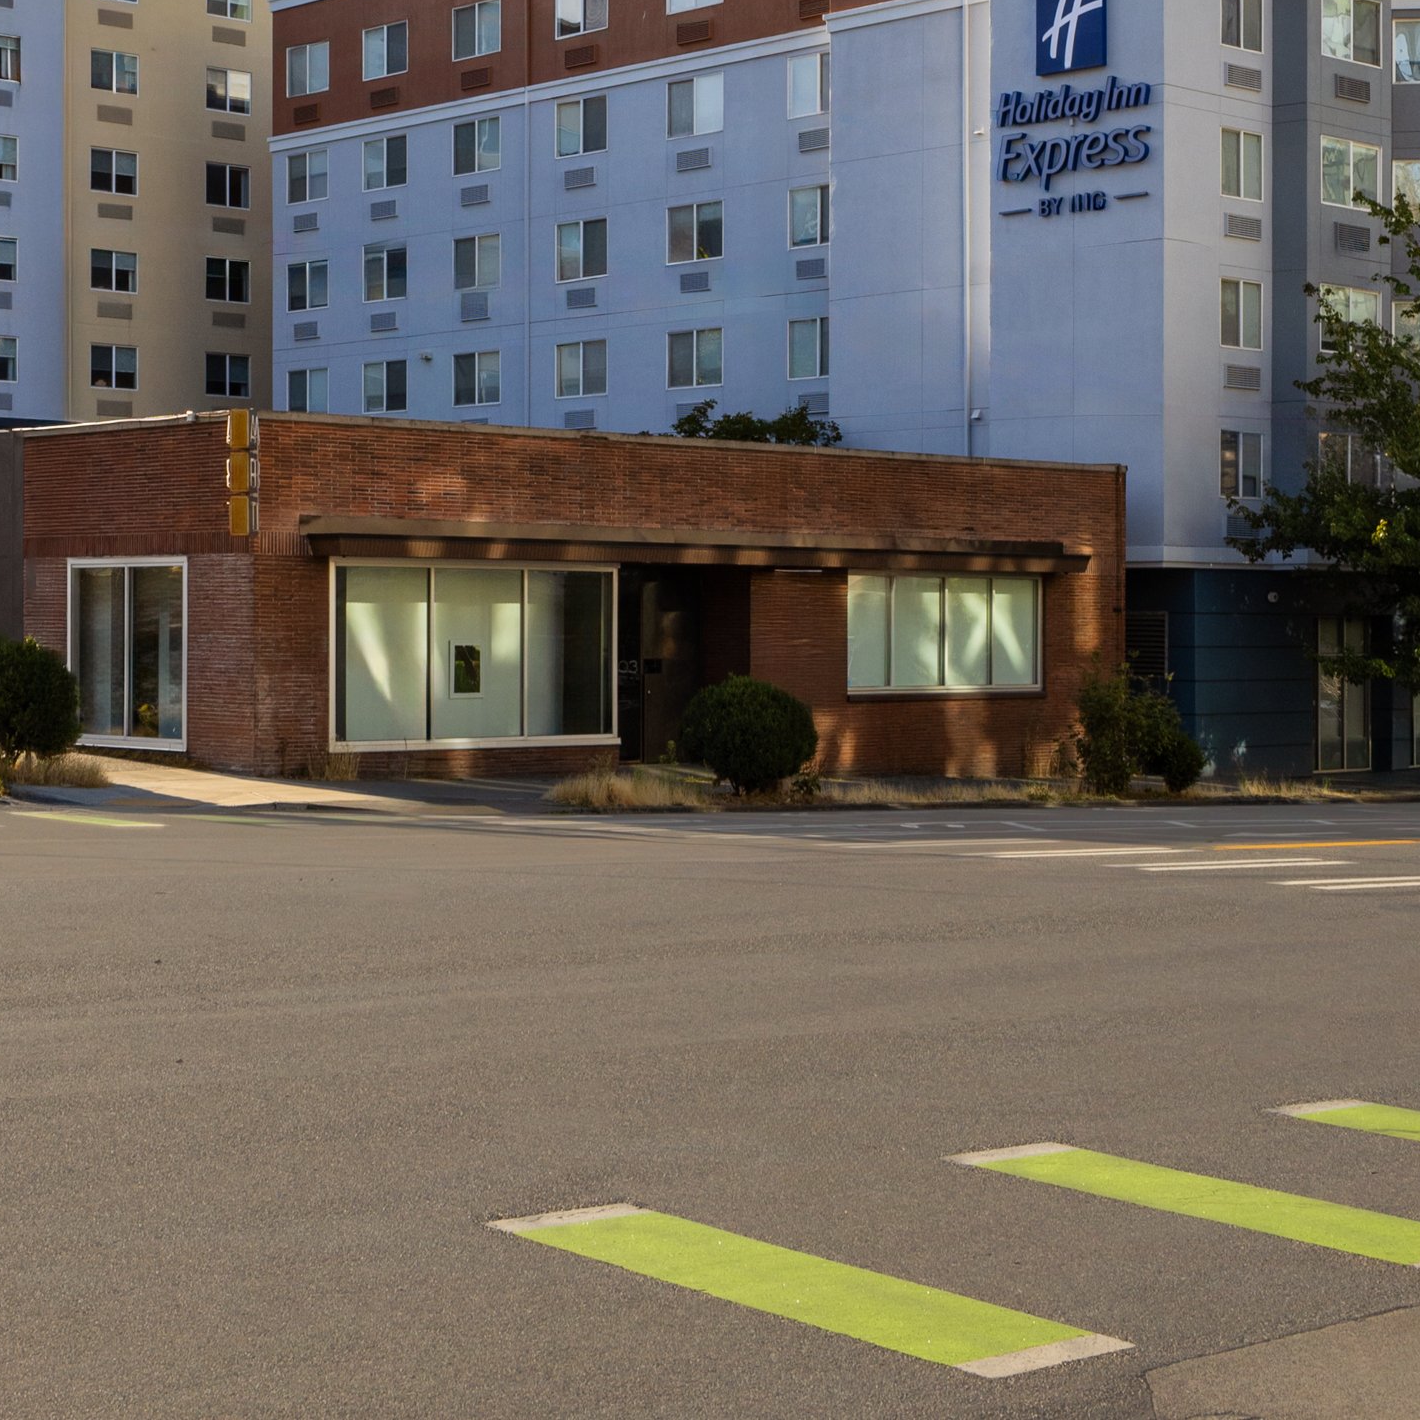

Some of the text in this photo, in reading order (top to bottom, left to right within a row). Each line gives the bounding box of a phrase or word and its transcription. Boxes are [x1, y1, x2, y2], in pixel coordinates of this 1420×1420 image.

[997, 75, 1151, 127] Holiday Inn
[996, 124, 1151, 192] Express
[1038, 196, 1064, 218] BY
